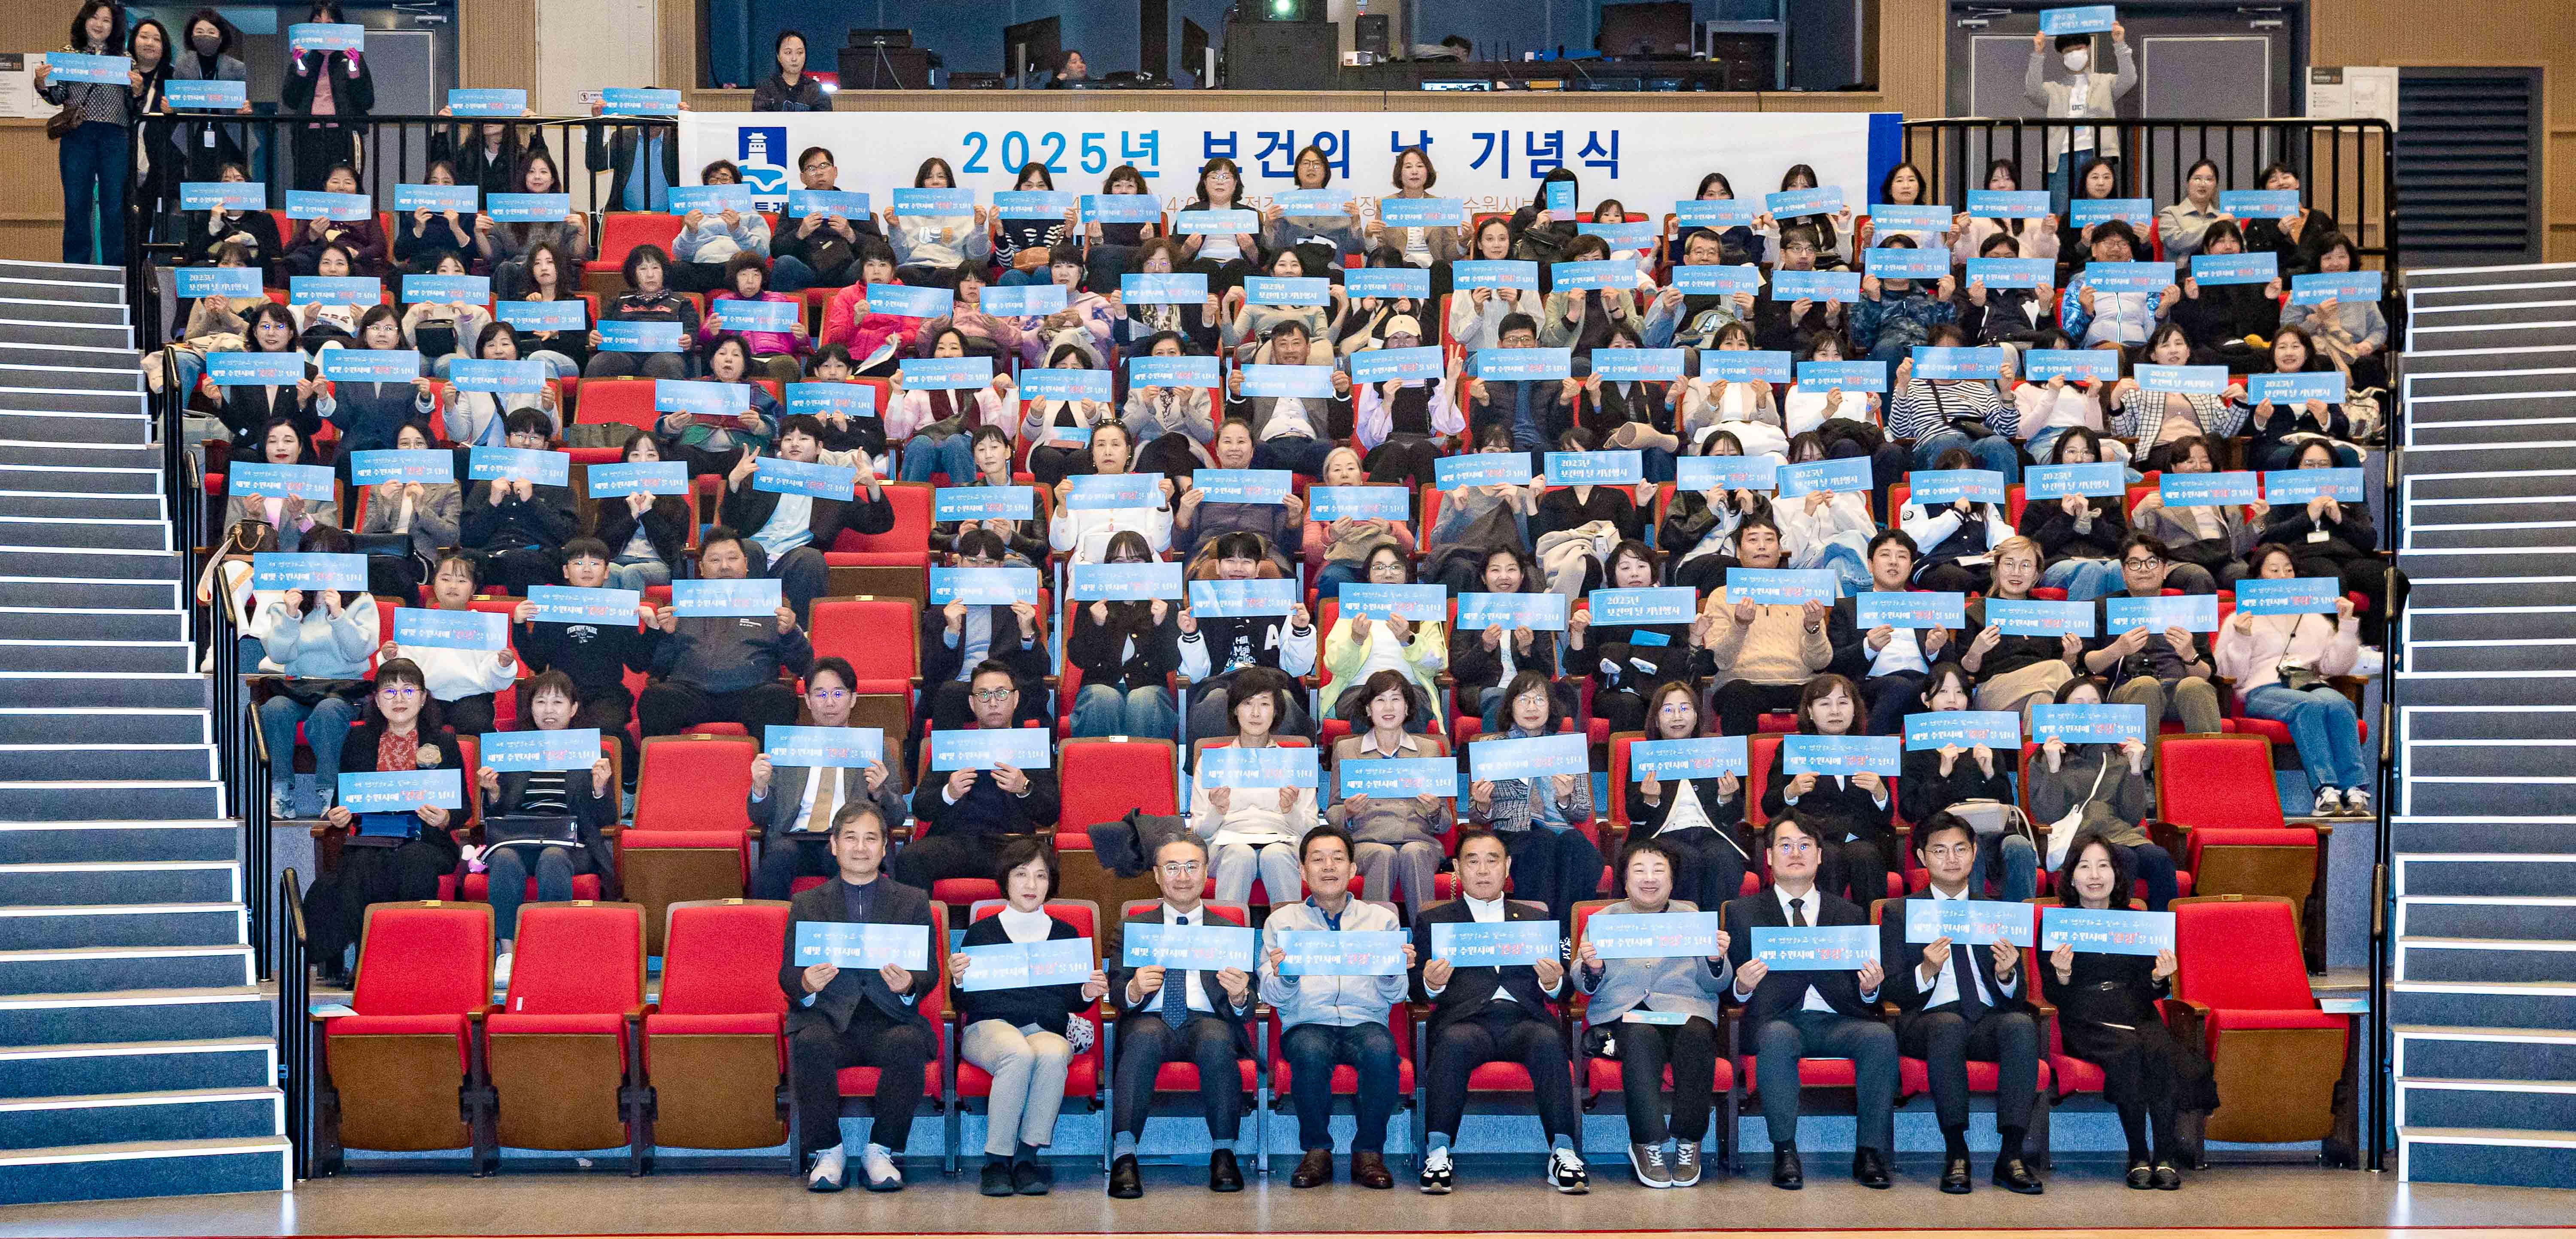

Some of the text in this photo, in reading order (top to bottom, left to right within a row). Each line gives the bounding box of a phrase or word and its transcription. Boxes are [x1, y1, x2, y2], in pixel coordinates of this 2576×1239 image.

[963, 129, 1160, 178] 2025년
[1198, 130, 1349, 179] 보건의
[1470, 130, 1619, 179] 기념식
